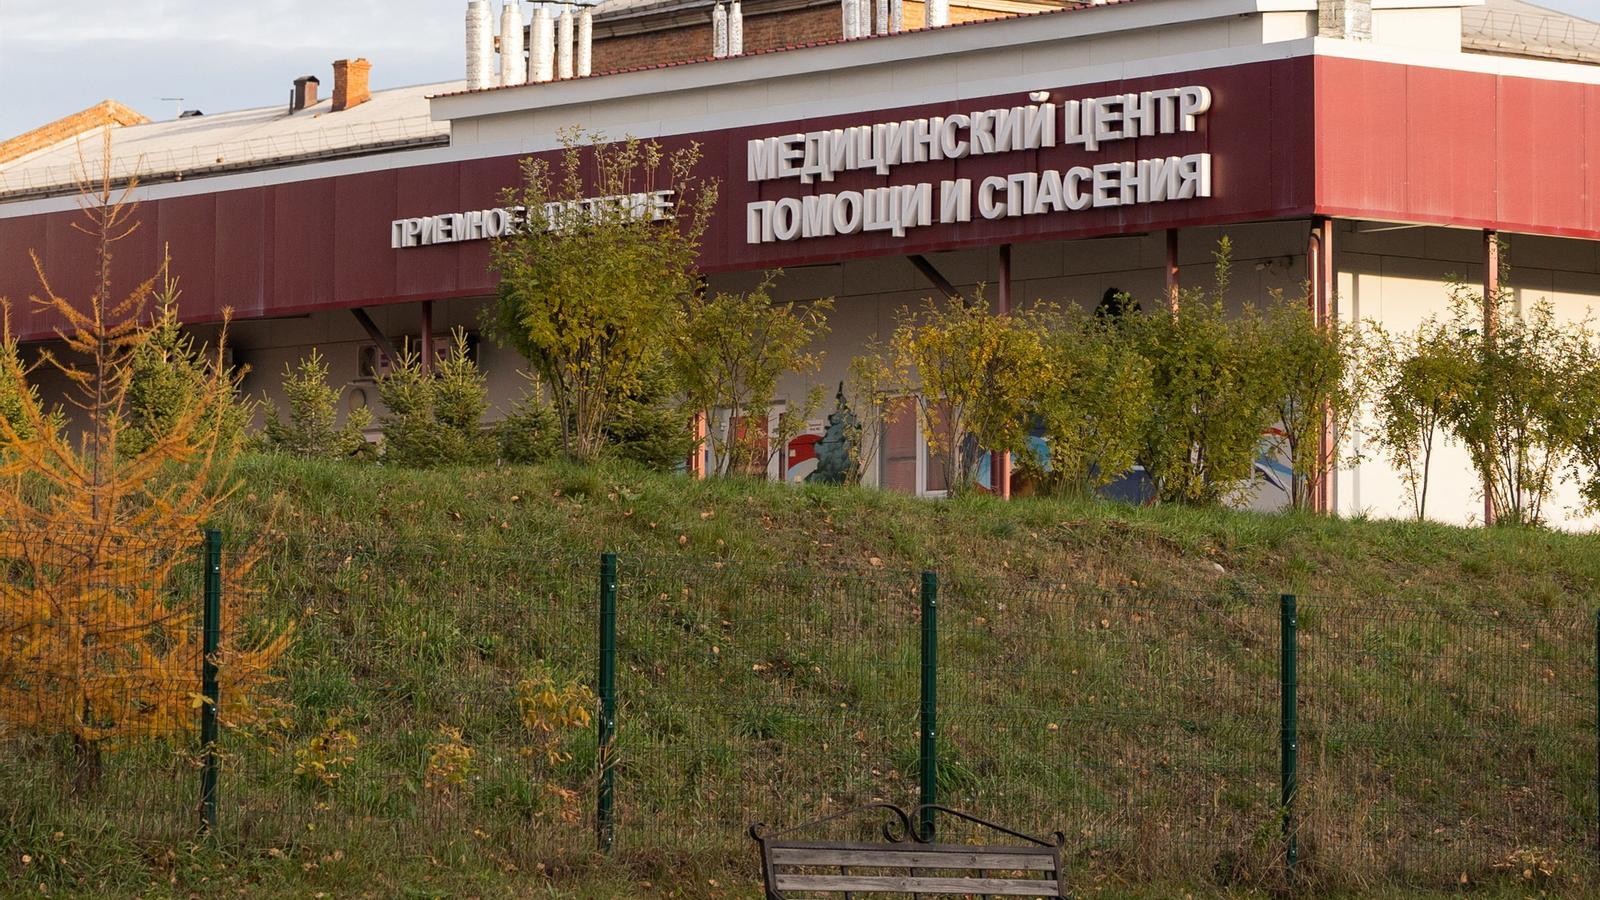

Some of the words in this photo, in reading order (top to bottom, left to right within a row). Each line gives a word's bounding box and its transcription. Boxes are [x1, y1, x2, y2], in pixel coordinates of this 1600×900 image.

[747, 91, 1056, 184] МЕДИЦИНСКИЙ
[1064, 85, 1212, 152] ЦЕНТР
[391, 206, 525, 248] ПРИЕМНОЕ
[746, 182, 932, 244] ПОМОЩИ
[939, 178, 972, 223] И
[978, 152, 1212, 220] СПАСЕНИЯ
